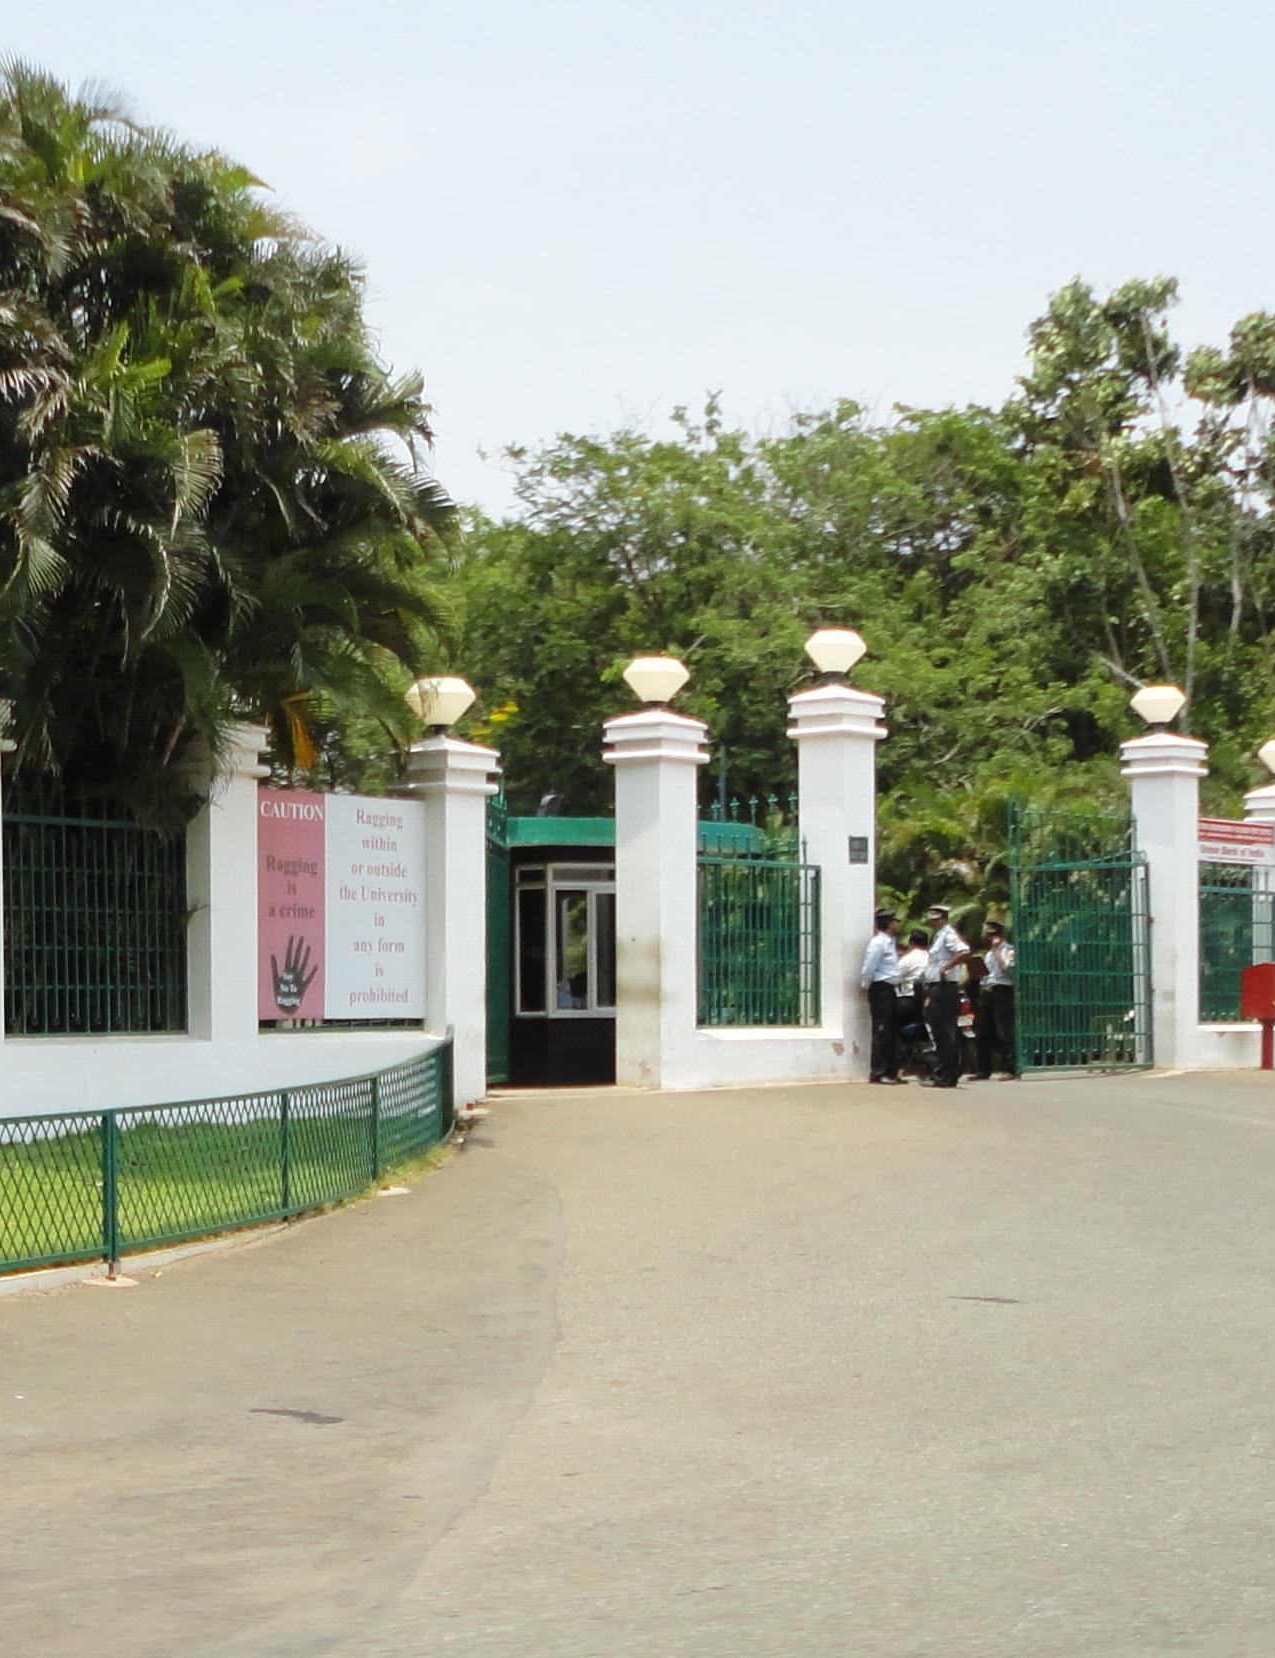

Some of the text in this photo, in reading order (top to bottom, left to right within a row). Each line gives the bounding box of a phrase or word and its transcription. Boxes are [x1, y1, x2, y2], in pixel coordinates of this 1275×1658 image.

[260, 800, 324, 821] CAUTION
[356, 808, 404, 829] Ragging
[362, 836, 398, 852] within
[266, 854, 319, 876] Ragging
[351, 861, 408, 878] or outside
[287, 879, 297, 895] is
[339, 885, 418, 907] the University
[268, 902, 316, 919] a crime
[374, 912, 386, 927] in
[354, 937, 405, 956] any form
[375, 963, 384, 978] is
[349, 988, 409, 1008] prohibited
